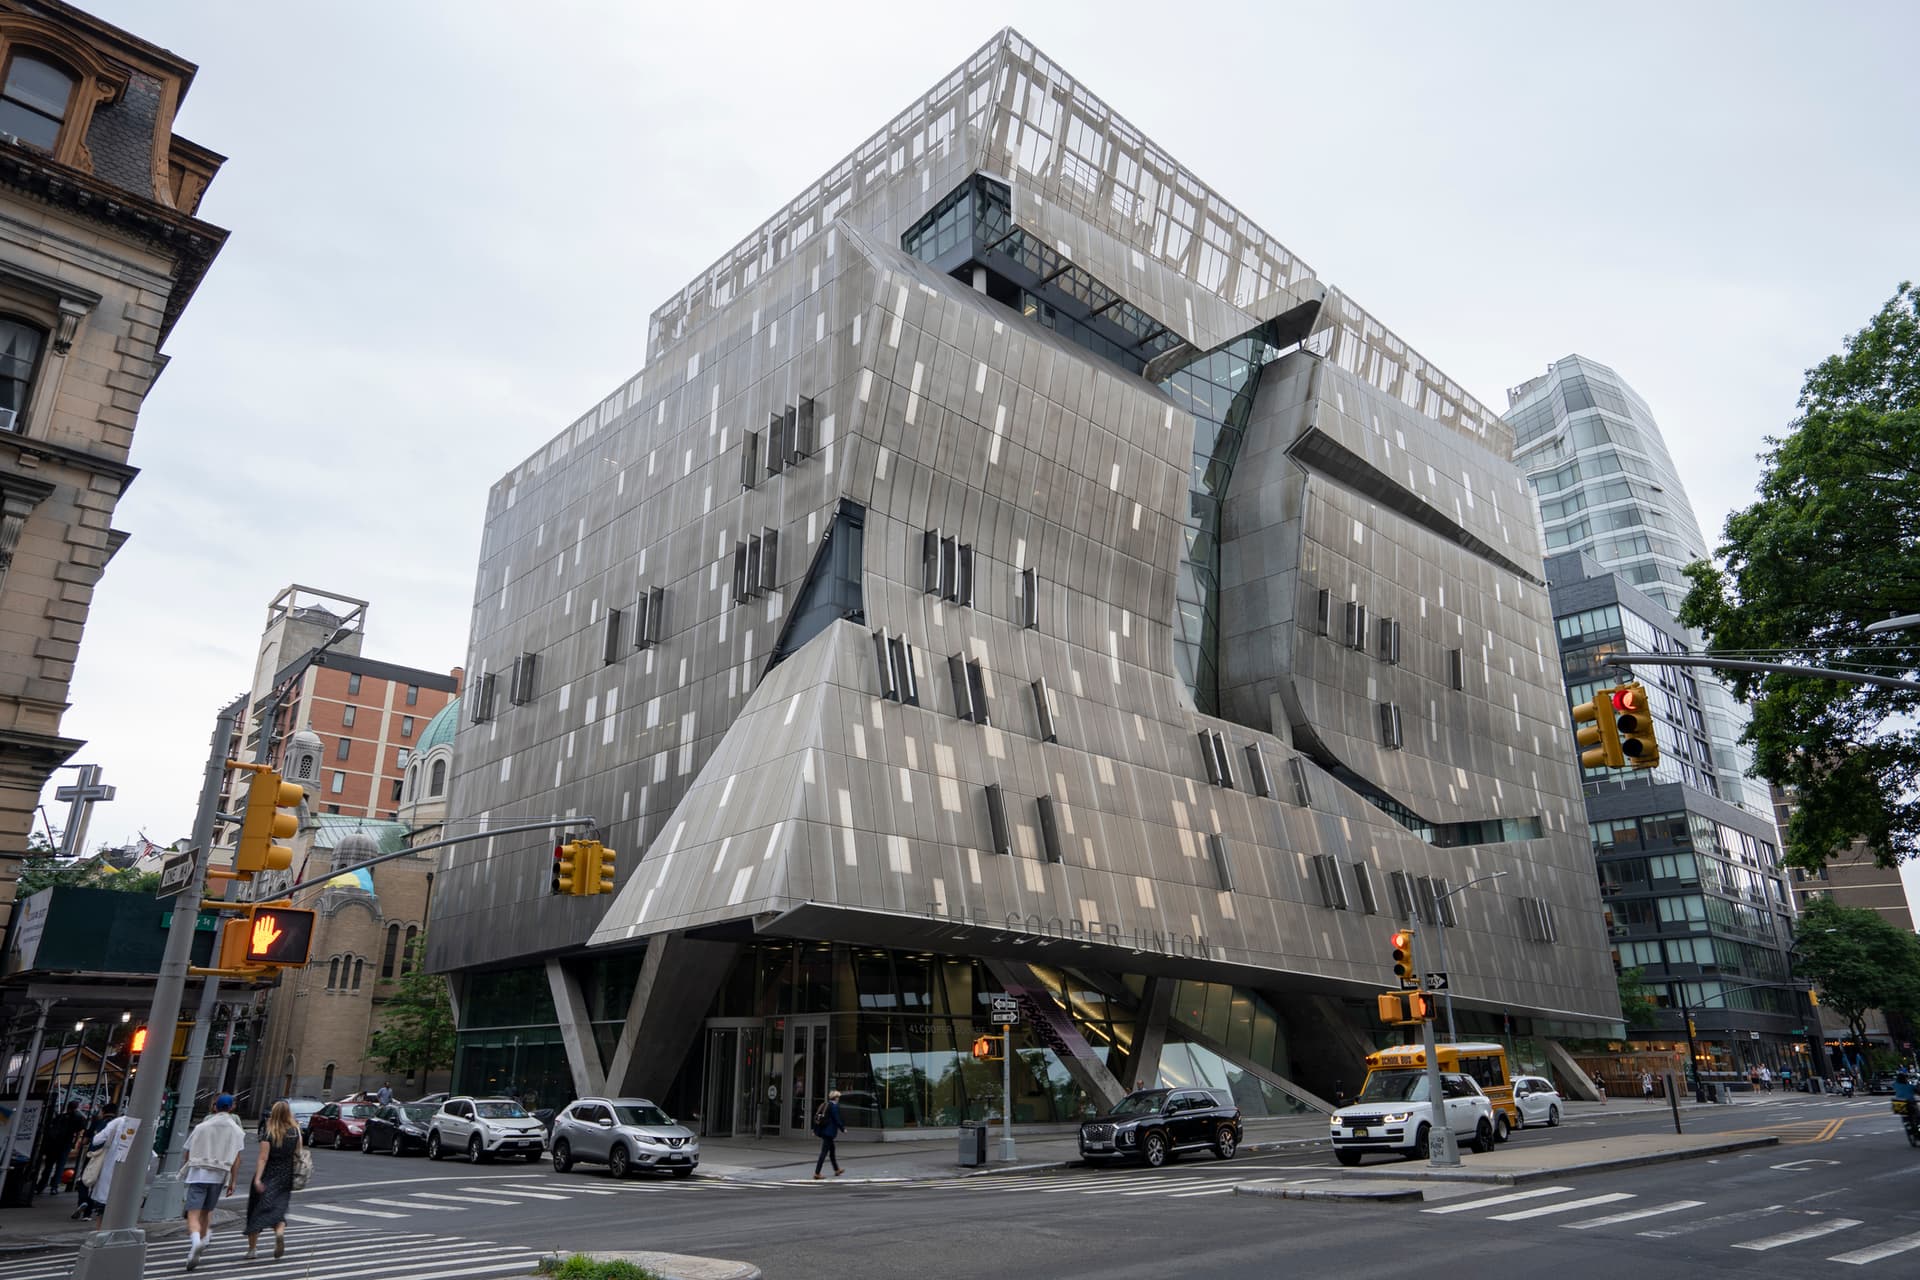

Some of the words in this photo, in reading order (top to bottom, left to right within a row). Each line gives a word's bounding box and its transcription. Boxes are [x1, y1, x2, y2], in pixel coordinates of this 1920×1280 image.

[164, 868, 177, 884] ONE
[180, 862, 192, 878] WAY
[925, 902, 988, 927] THE
[1005, 911, 1120, 947] COOPER
[1134, 927, 1209, 960] UNION
[1381, 1056, 1399, 1065] SCHOOL
[1401, 1056, 1412, 1065] BUS
